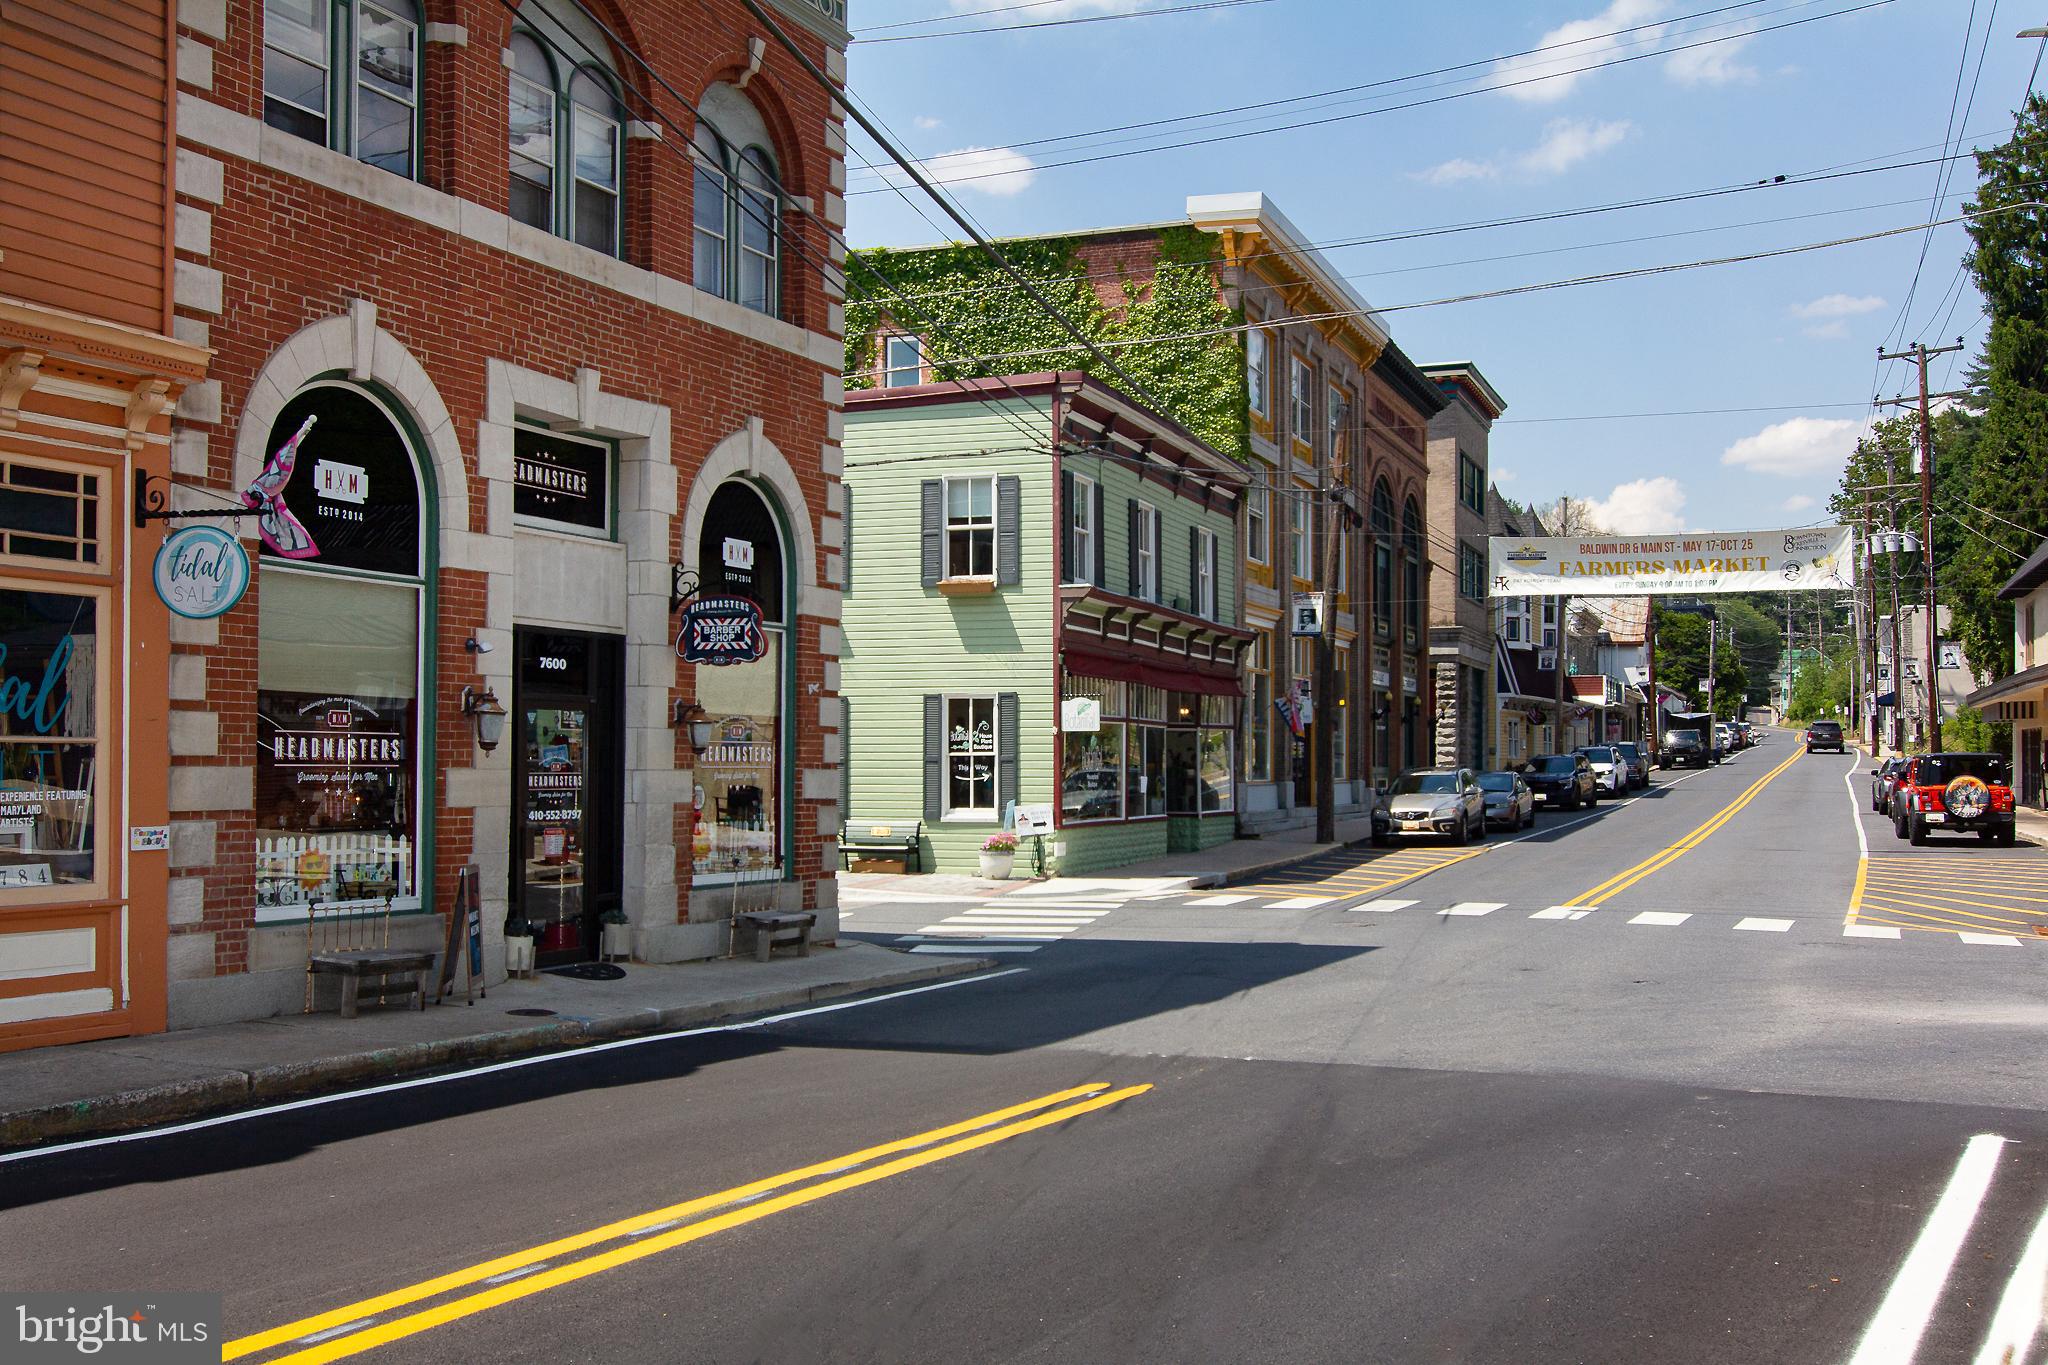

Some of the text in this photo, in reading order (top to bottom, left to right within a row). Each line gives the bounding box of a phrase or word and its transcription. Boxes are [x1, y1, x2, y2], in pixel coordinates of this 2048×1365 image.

[342, 510, 363, 522] 2014
[1580, 543, 1617, 555] BALDWIN
[1619, 543, 1631, 554] DR
[1633, 543, 1639, 554] &
[1641, 542, 1663, 554] MAIN
[1664, 541, 1675, 553] ST
[1683, 541, 1703, 553] MAY
[1706, 540, 1738, 552] 17-OCT
[1741, 539, 1753, 550] 25
[169, 542, 229, 582] tidal
[1559, 560, 1666, 576] FARMERS
[1673, 556, 1770, 574] MARKET
[174, 585, 223, 603] SALT
[690, 600, 750, 614] HEADMASTERS
[704, 625, 741, 634] BARBER
[709, 633, 735, 642] SHOP
[540, 656, 567, 670] 7600
[274, 736, 400, 760] HEADMASTERS
[297, 771, 329, 783] Grooming
[350, 771, 363, 784] for
[364, 772, 379, 781] Men
[528, 775, 582, 787] HEADMASTERS
[0, 790, 87, 801] EXPERIENCE FEATURING
[0, 804, 42, 815] MARYLAND
[528, 809, 582, 820] 410-552-8797
[0, 817, 35, 827] ARTISTS
